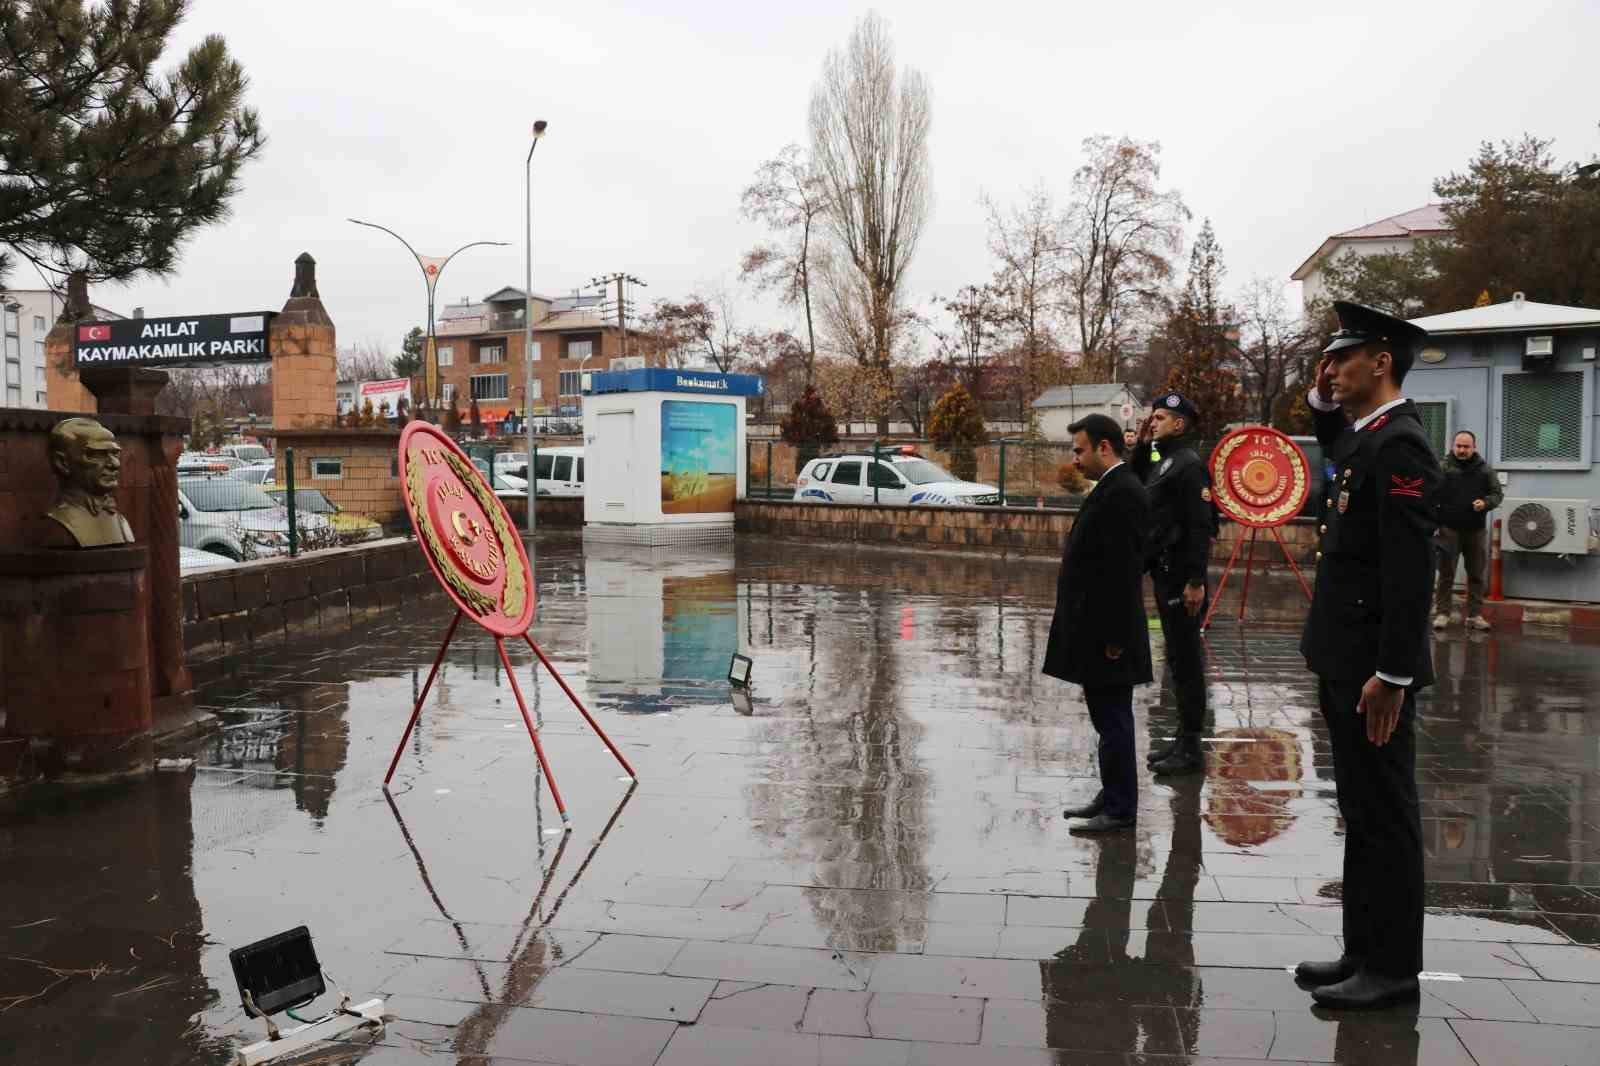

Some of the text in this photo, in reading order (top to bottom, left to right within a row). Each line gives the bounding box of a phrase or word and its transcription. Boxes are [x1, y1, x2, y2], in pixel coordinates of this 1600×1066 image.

[141, 321, 199, 338] AHLAT
[78, 338, 265, 362] KAYMAKAMLIK PARKI
